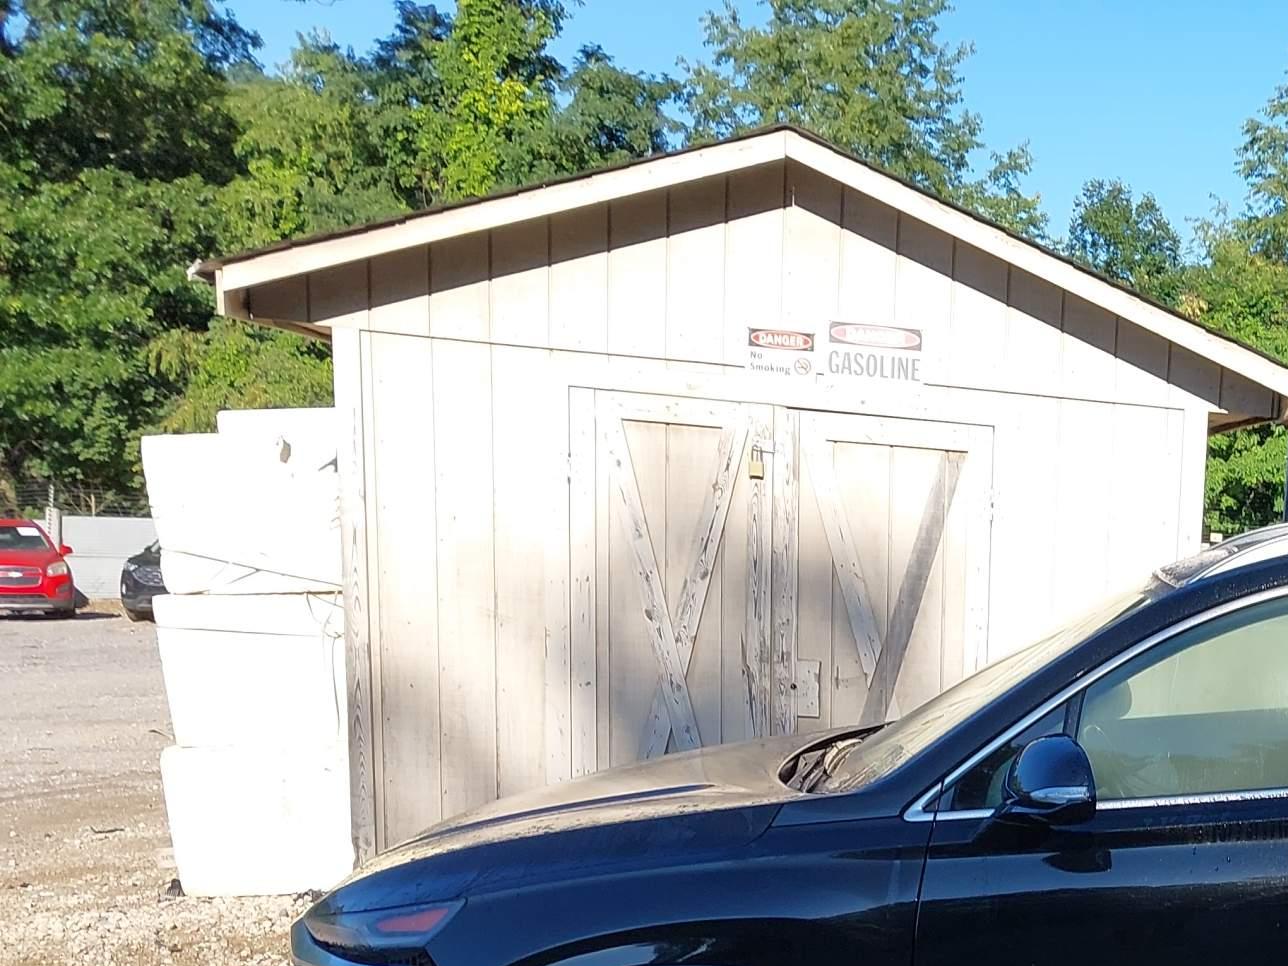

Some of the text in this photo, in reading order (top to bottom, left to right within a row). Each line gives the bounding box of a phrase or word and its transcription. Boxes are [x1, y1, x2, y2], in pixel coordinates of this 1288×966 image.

[759, 333, 803, 347] DANGER
[750, 351, 762, 359] No
[750, 362, 790, 375] Smoking
[829, 350, 921, 381] GASOLINE
